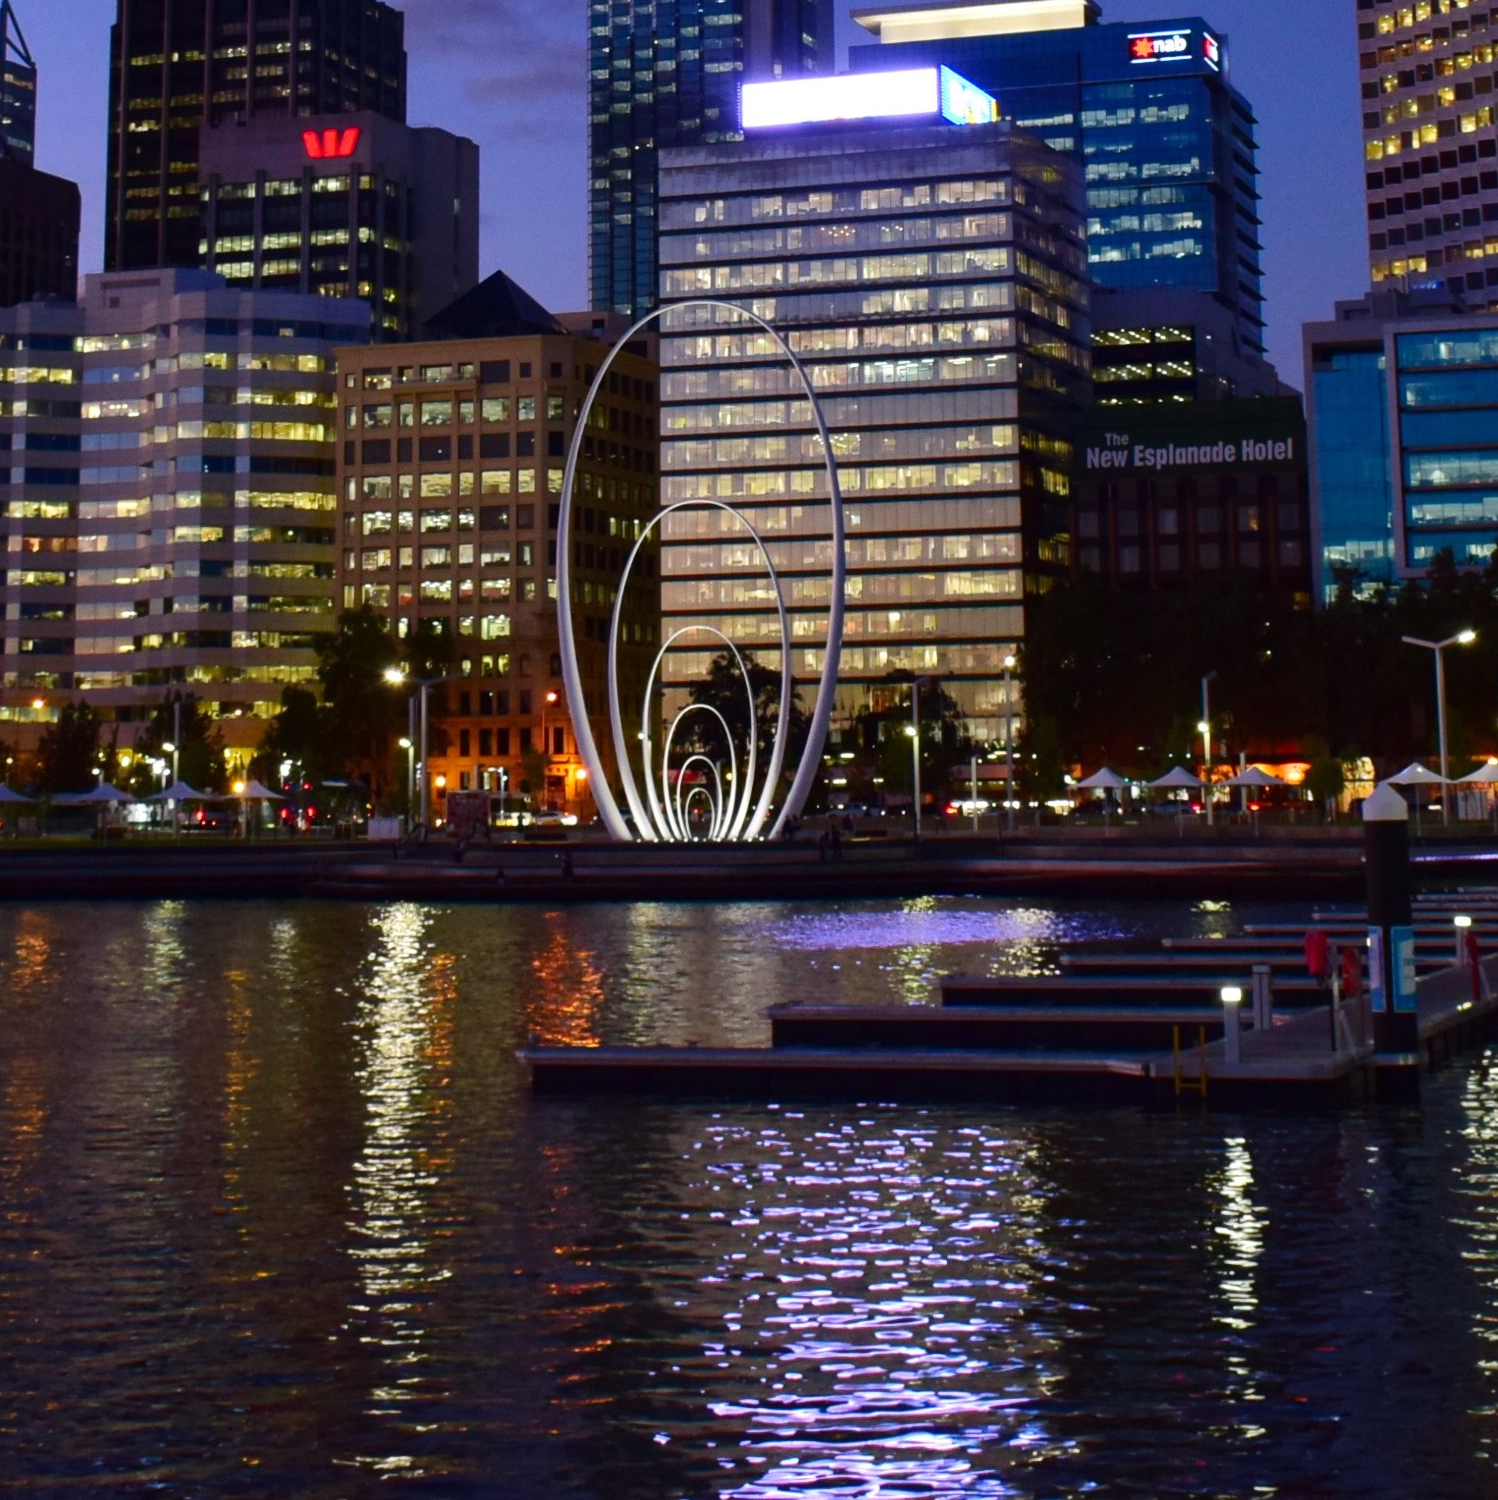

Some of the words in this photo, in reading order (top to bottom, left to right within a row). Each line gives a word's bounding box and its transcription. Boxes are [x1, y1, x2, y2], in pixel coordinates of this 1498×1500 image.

[1153, 35, 1187, 53] nab
[1105, 433, 1129, 446] The
[1086, 447, 1128, 469] New
[1133, 442, 1236, 470] Esplanade
[1242, 437, 1293, 462] Hotel
